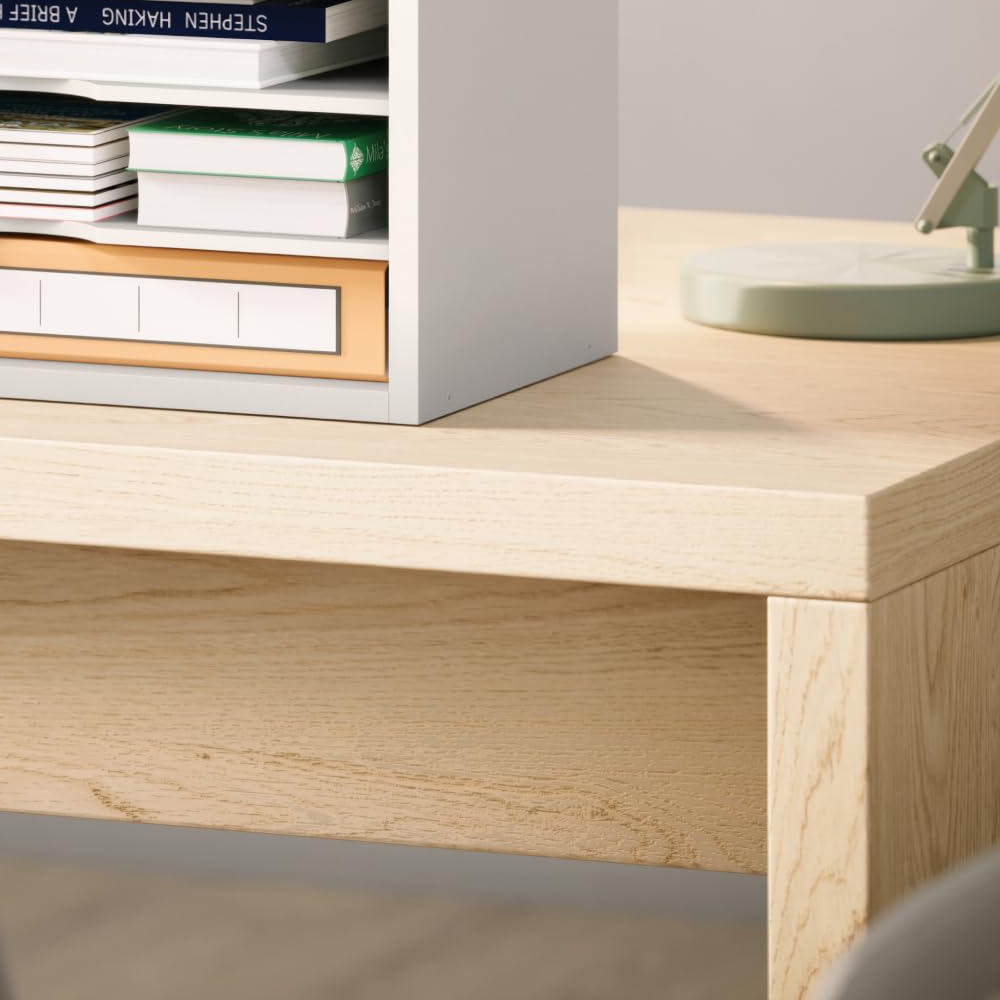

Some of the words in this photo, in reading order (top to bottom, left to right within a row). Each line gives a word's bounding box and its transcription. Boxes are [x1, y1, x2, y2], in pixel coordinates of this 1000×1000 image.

[8, 3, 60, 23] BRIEF
[66, 6, 78, 24] A
[102, 7, 171, 29] HAKING
[185, 11, 268, 33] STEPHEN
